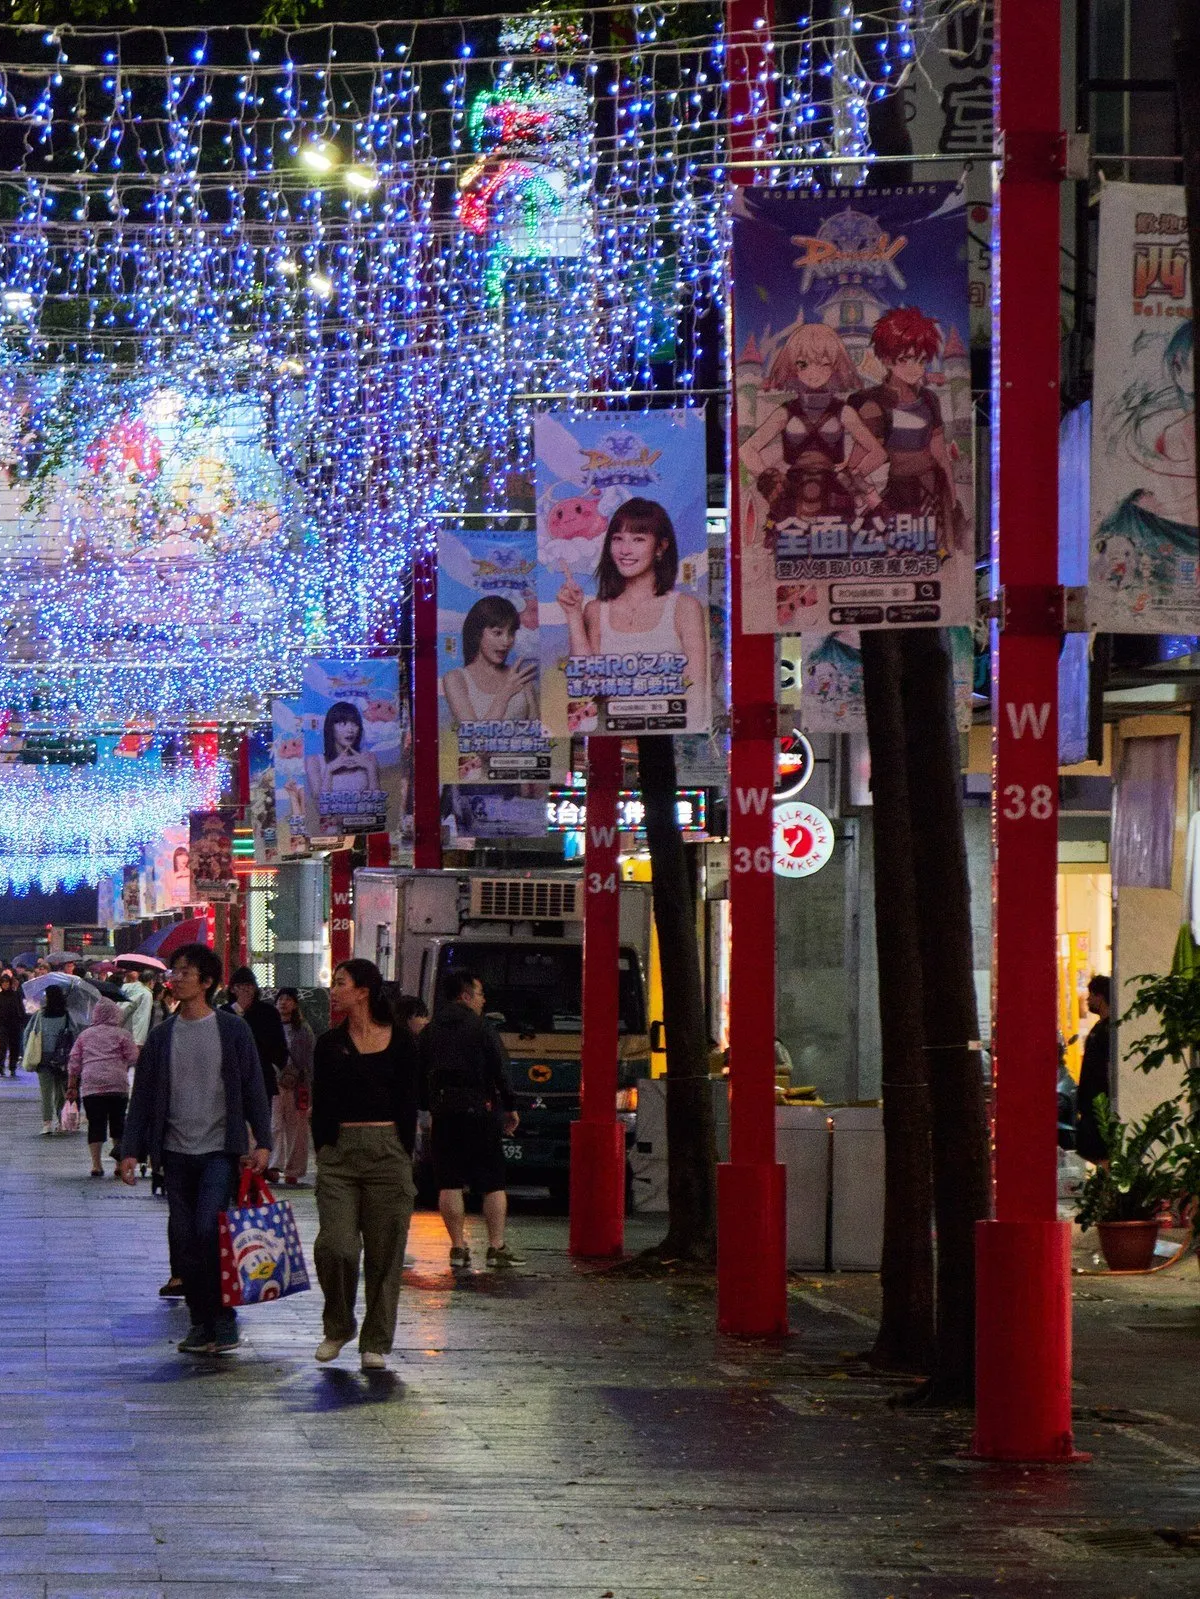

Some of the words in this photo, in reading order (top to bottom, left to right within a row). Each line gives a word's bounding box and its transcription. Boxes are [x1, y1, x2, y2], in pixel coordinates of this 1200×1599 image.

[775, 510, 937, 556] 全面公測!
[1006, 702, 1050, 740] W
[736, 787, 770, 815] W
[1003, 784, 1053, 820] 38
[591, 826, 616, 848] W
[733, 846, 771, 873] 36
[588, 872, 617, 894] 34
[334, 892, 349, 905] W
[332, 918, 350, 931] 28
